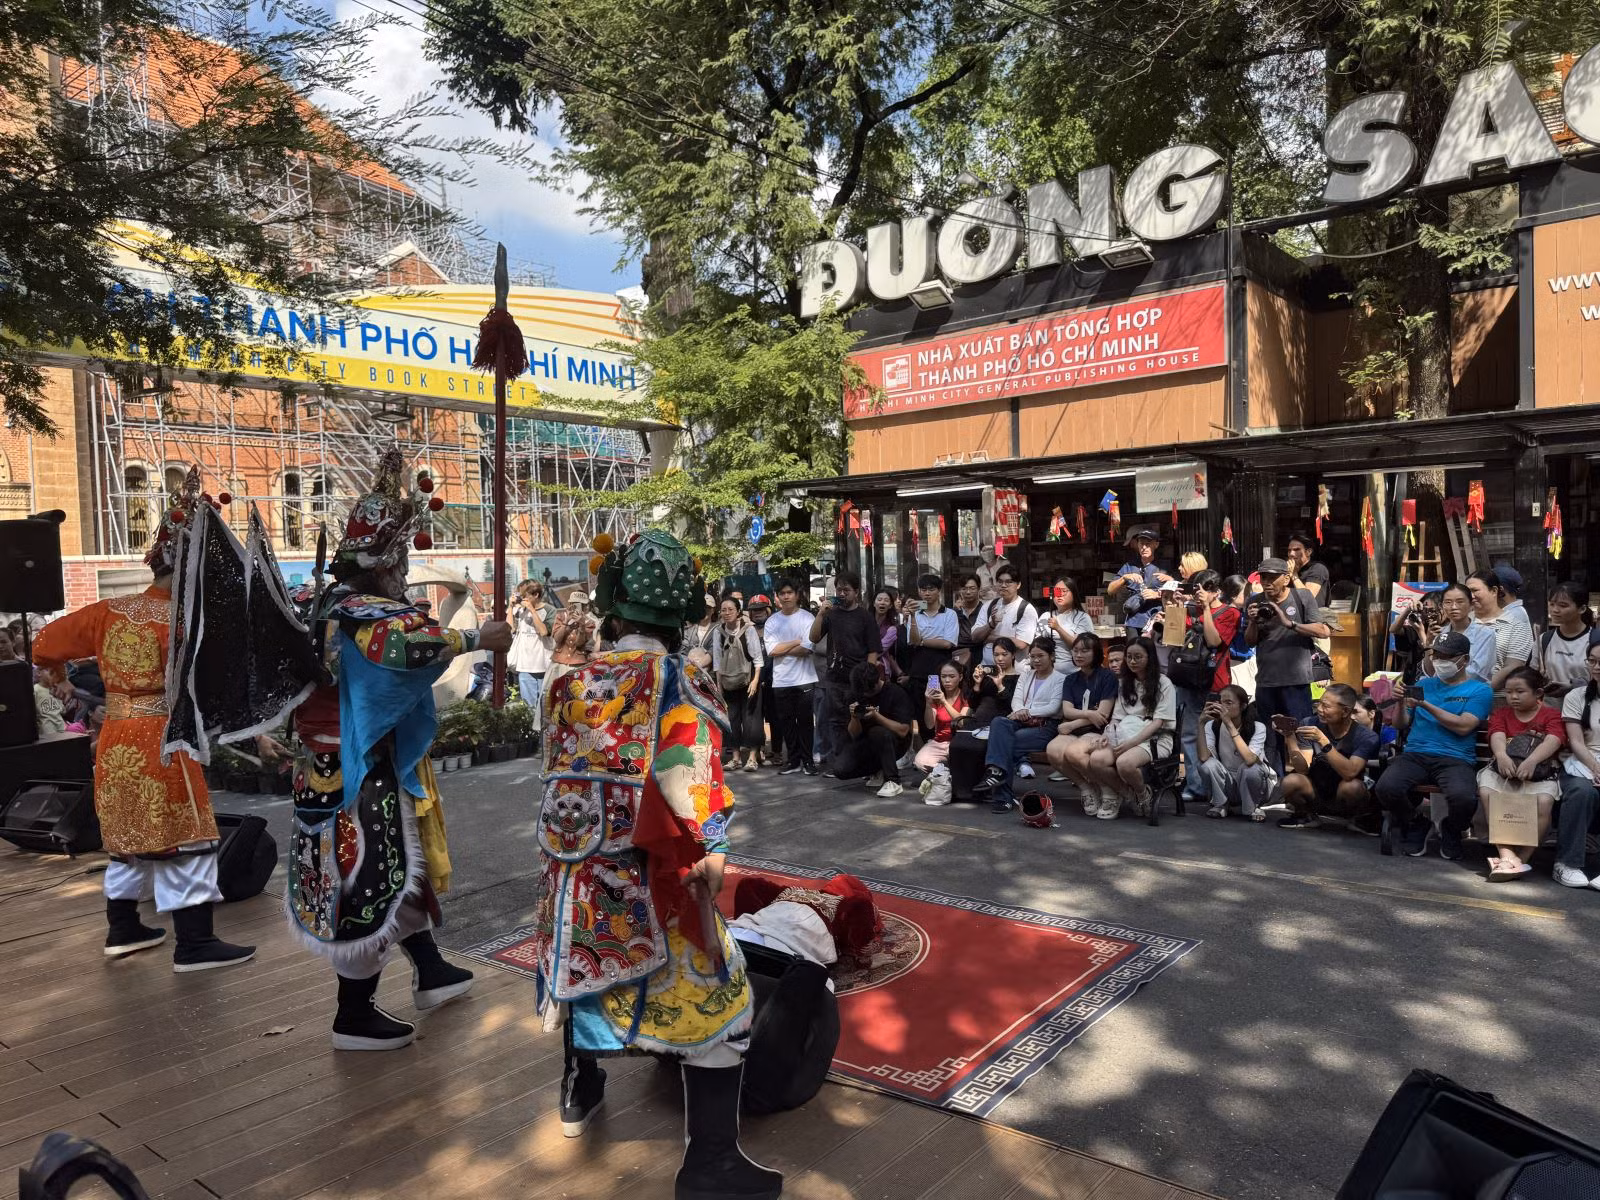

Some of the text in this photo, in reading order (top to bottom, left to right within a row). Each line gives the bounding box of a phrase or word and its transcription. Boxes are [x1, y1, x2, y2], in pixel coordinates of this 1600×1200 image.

[798, 143, 1225, 318] ĐƯỜNG
[360, 325, 438, 361] PHỐ
[520, 347, 558, 379] HÍ
[567, 356, 637, 391] MINH
[917, 307, 1163, 367] NHÀ XUẤT BẢN TỔNG HỢP
[918, 333, 1159, 387] THÀNH PHỐ HỒ CHÍ MINH
[369, 366, 428, 388] BOOK
[448, 377, 527, 400] STRET
[905, 393, 936, 405] MINH
[942, 388, 970, 400] CITY
[977, 378, 1037, 394] GENERAL
[1045, 362, 1137, 385] PUBLISHING
[1146, 352, 1200, 369] HOUSE
